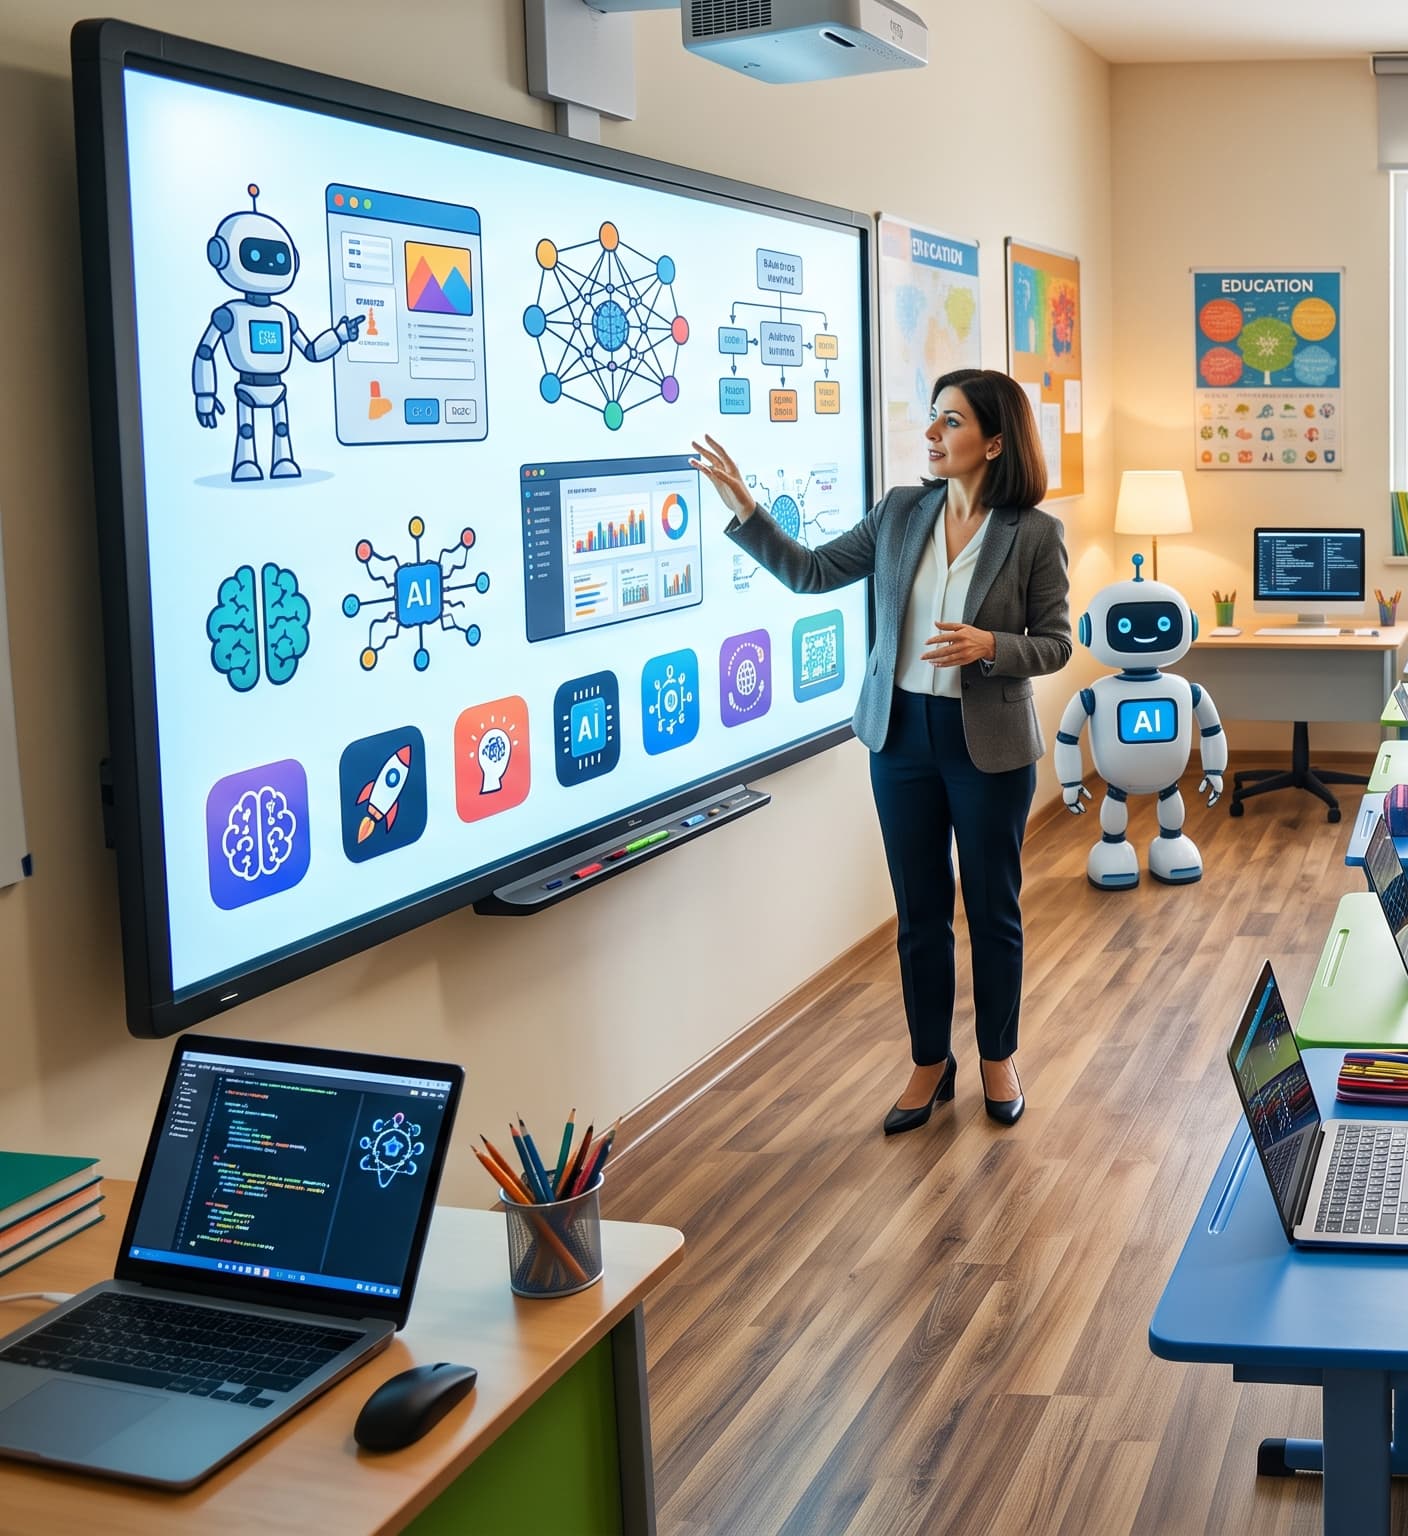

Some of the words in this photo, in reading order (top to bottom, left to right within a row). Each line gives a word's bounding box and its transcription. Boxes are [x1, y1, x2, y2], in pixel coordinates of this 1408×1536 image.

[1221, 279, 1314, 293] EDUCATION
[406, 578, 432, 609] AI
[578, 712, 599, 742] AI
[1133, 709, 1161, 734] AI
